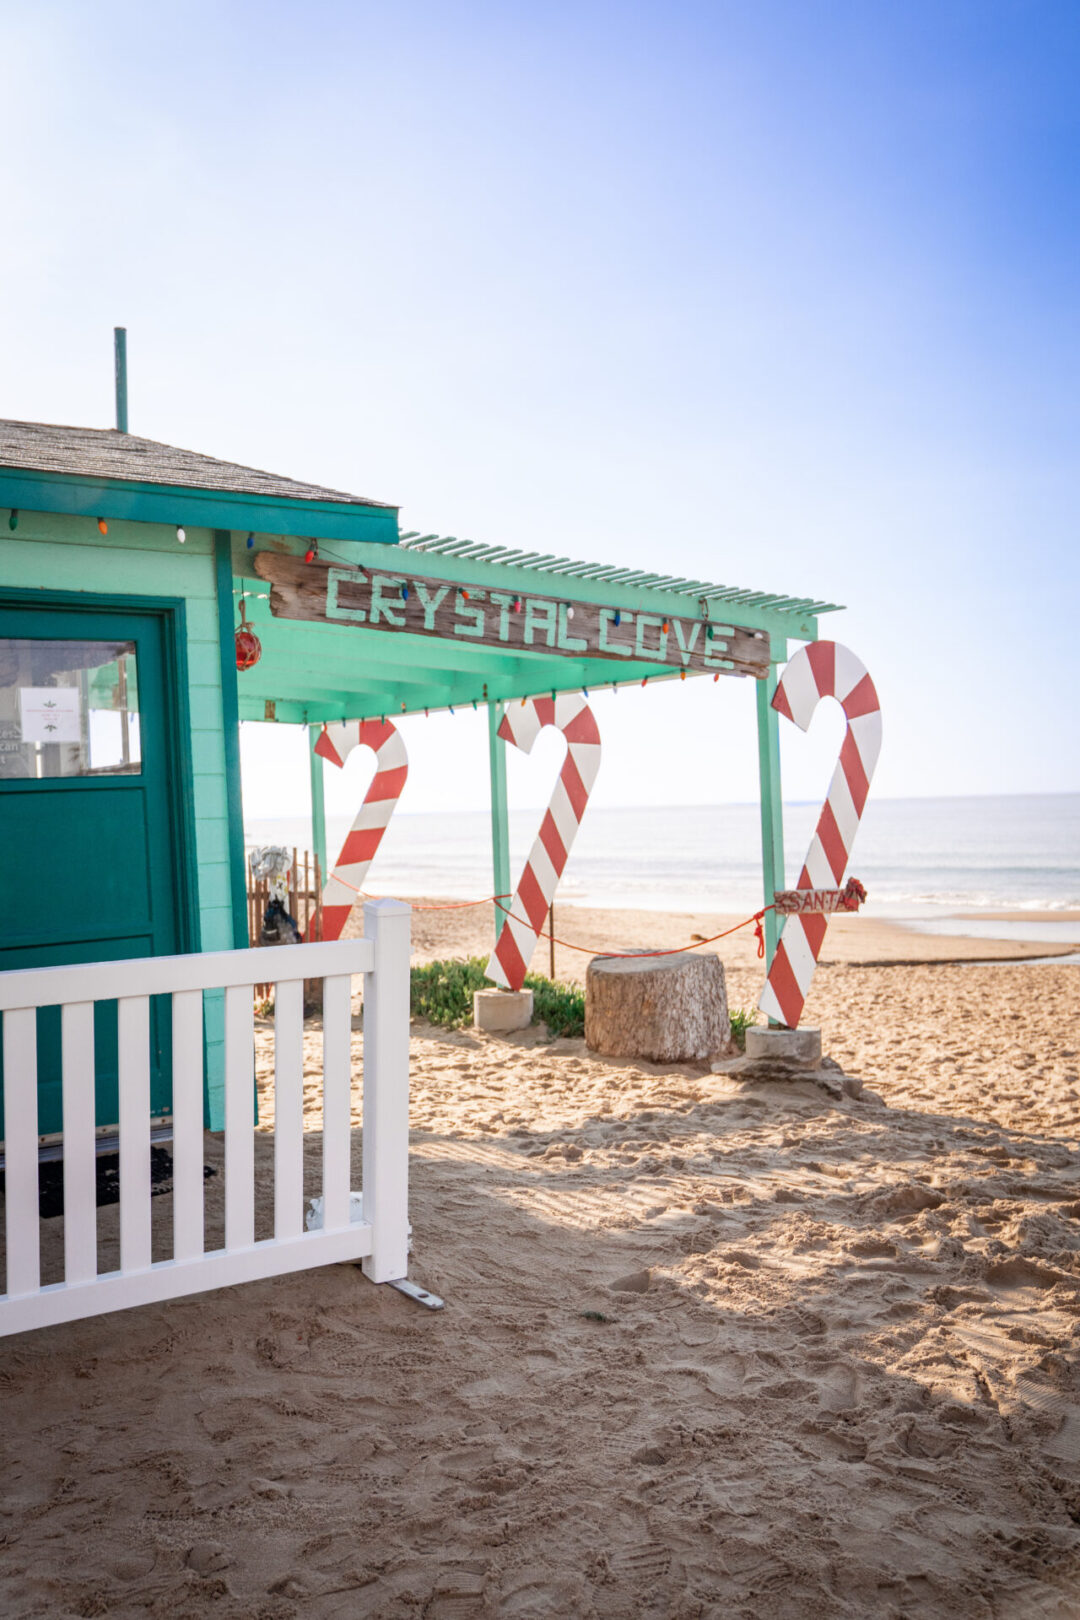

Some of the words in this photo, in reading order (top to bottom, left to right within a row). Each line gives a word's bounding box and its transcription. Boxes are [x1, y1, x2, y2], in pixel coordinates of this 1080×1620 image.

[326, 567, 588, 652] CRYSTAL
[600, 610, 735, 669] COVE
[786, 891, 847, 912] SANTA
